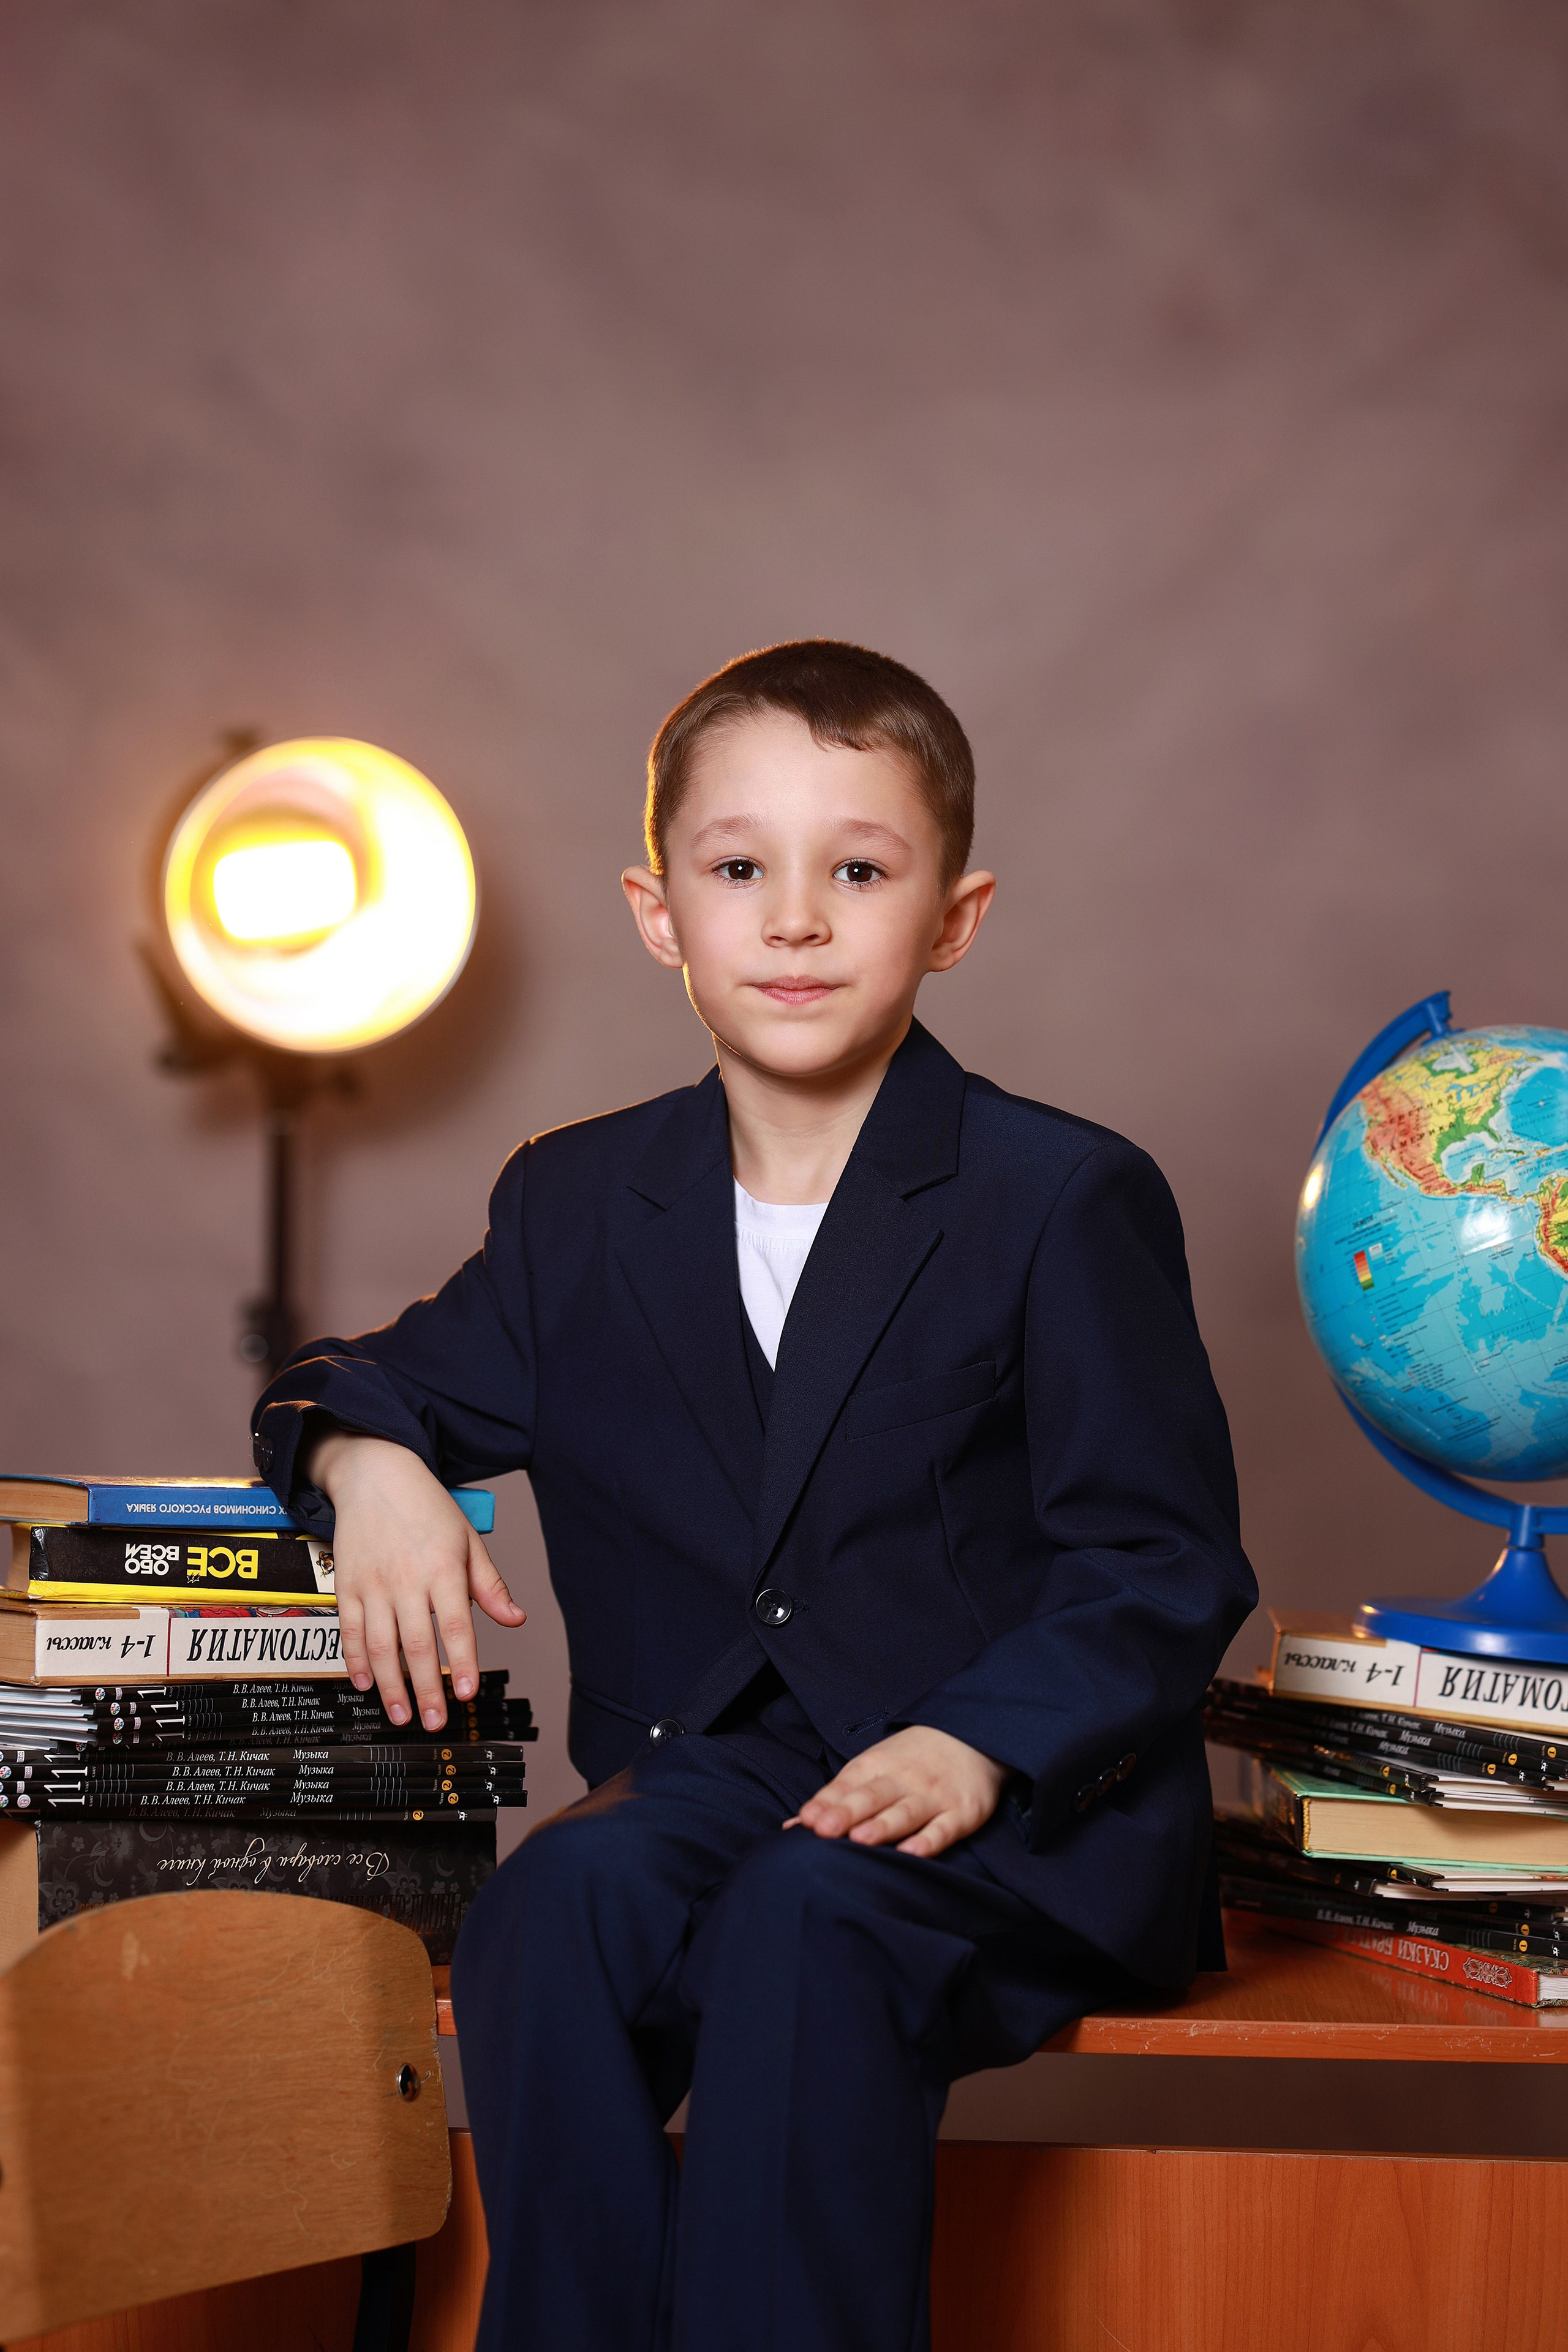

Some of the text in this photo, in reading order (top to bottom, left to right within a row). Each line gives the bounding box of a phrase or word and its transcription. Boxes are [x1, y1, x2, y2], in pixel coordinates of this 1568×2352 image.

[126, 1503, 156, 1513] ЯЗЫКА
[159, 1503, 211, 1514] РУССКОГО
[214, 1504, 276, 1515] СИНОНИМОВ
[125, 1543, 179, 1561] ВСЕМ
[124, 1558, 170, 1576] ОБО
[46, 1635, 156, 1659] 1-4 классы
[186, 1628, 345, 1663] ЕСТОМАТИЯ
[1284, 1652, 1405, 1686] 1-4 классы
[137, 1686, 167, 1698] 1
[337, 1694, 364, 1706] Музыка
[151, 1700, 178, 1713] 1
[352, 1706, 380, 1719] Музыка
[156, 1715, 186, 1728] 1
[43, 1753, 81, 1762] 1
[187, 1751, 216, 1762] Алеев,
[239, 1751, 270, 1761] Кичак
[293, 1749, 329, 1762] Музыка
[51, 1766, 88, 1778] 1
[194, 1766, 222, 1777] Алеев,
[246, 1766, 276, 1776] Кичак
[298, 1765, 334, 1776] Музыка
[43, 1781, 81, 1793] 1
[187, 1781, 216, 1792] Алеев,
[240, 1781, 271, 1791] Кичак
[293, 1779, 330, 1791] Музыка
[48, 1795, 85, 1807] 1
[162, 1795, 190, 1806] Алеев,
[215, 1795, 246, 1805] Кичак
[290, 1792, 333, 1806] Музыка
[156, 1838, 390, 1886] Все словари в одной книге
[1398, 1939, 1449, 1970] СКАЗКИ
